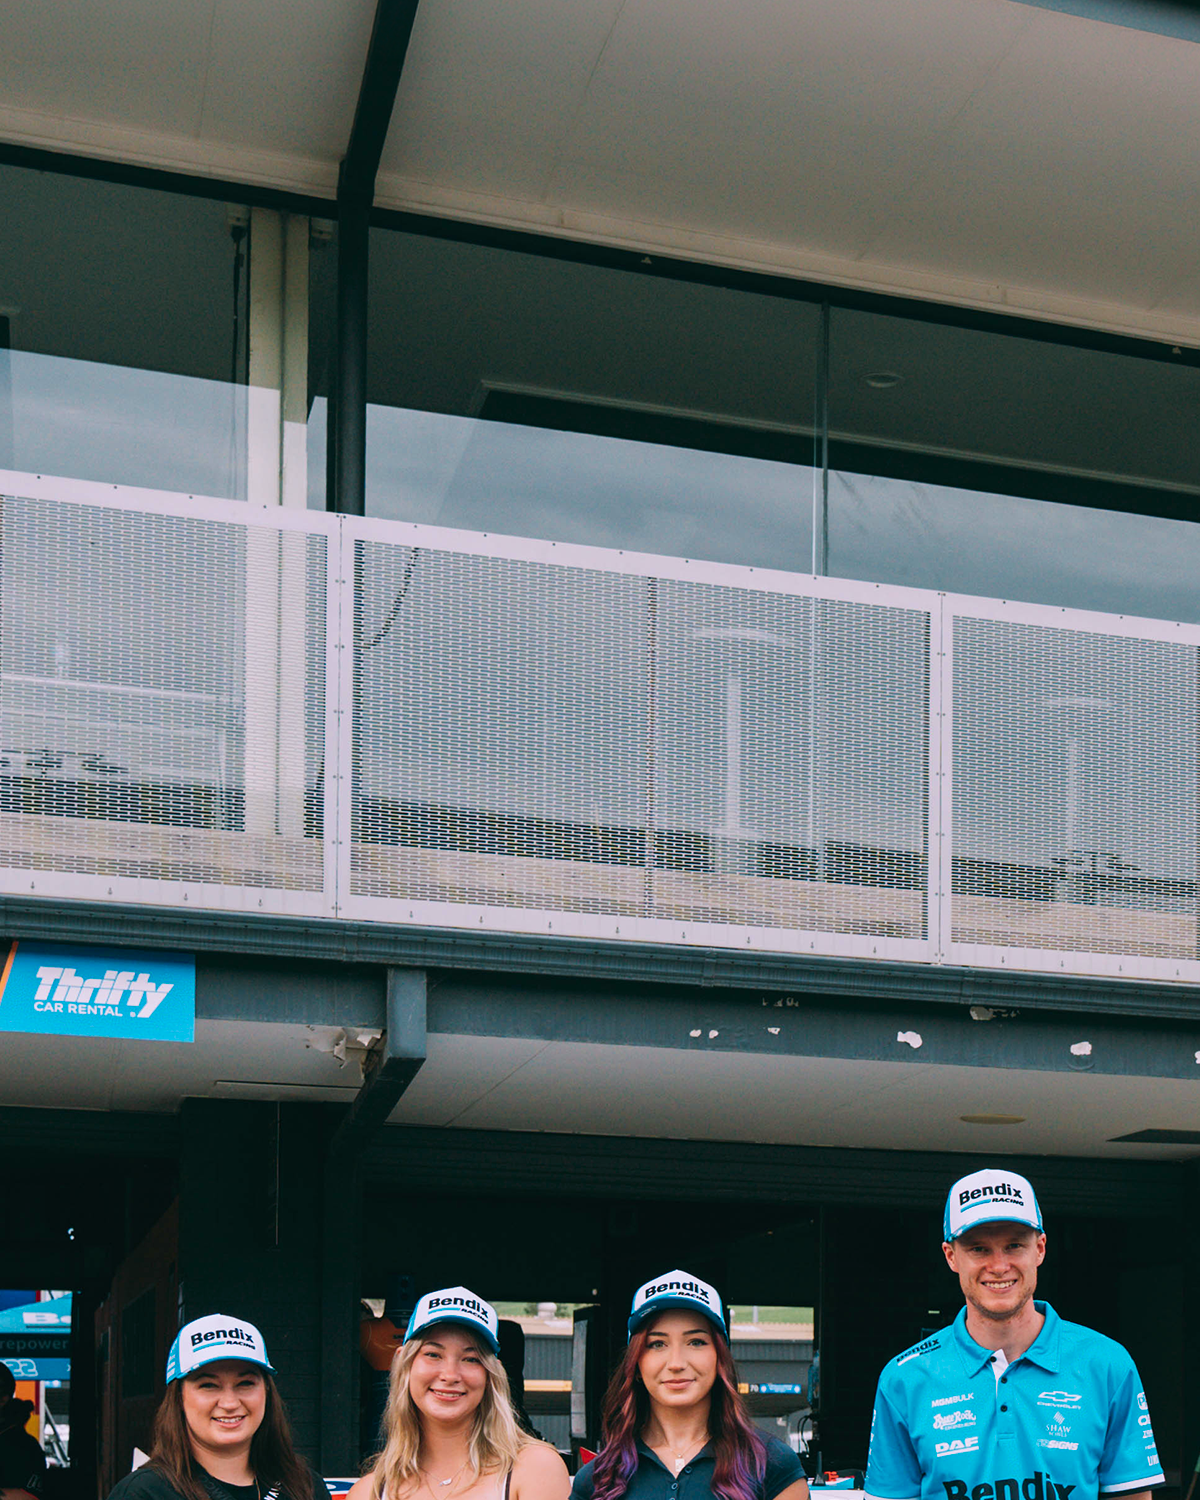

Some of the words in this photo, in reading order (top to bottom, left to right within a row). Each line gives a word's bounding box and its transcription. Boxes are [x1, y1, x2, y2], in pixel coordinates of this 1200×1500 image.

[34, 966, 174, 1018] Thrifty
[34, 1001, 64, 1013] CAR
[68, 1005, 123, 1017] RENTAL
[959, 1183, 1022, 1206] Bendix
[992, 1198, 1024, 1206] RACING
[645, 1281, 709, 1299] Bendix
[428, 1297, 489, 1319] Bendix
[191, 1328, 254, 1346] Bendix
[226, 1340, 256, 1350] RACING
[931, 1392, 974, 1408] MGMBULK
[1046, 1424, 1071, 1433] SHAW
[935, 1436, 979, 1453] DAF
